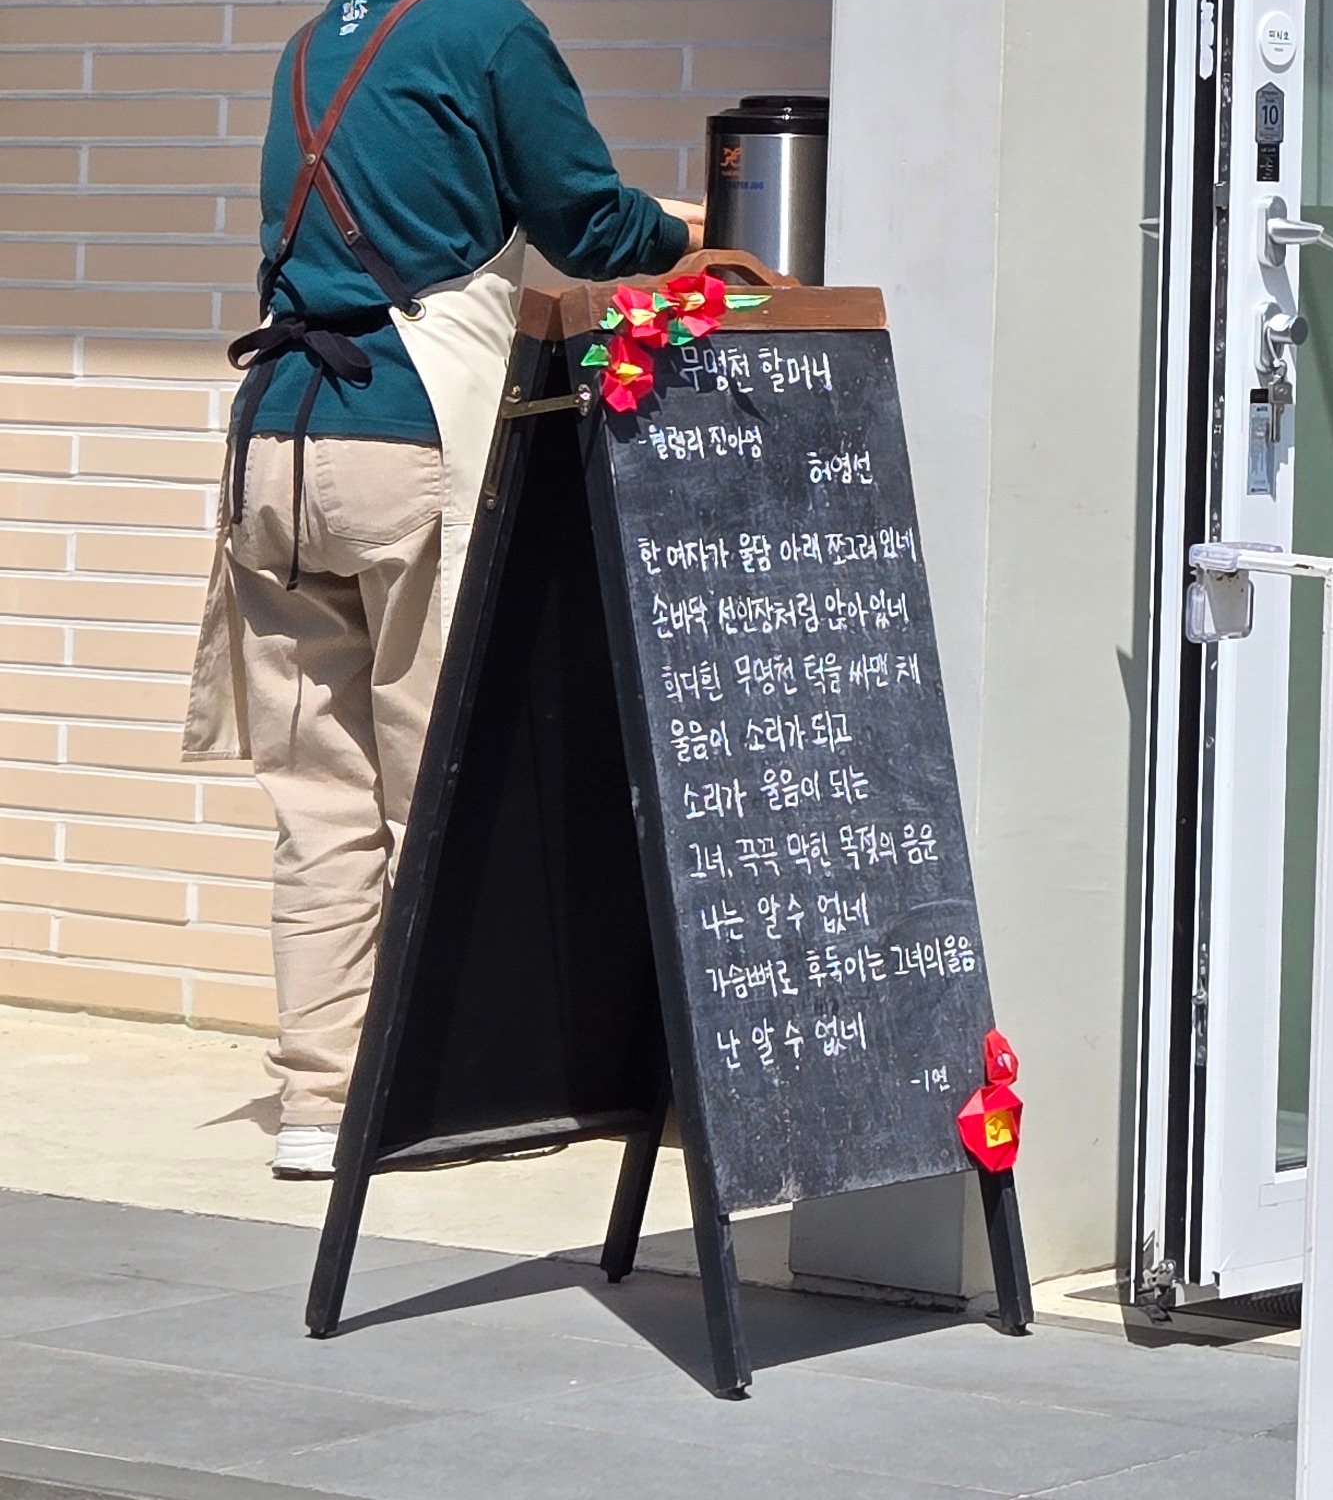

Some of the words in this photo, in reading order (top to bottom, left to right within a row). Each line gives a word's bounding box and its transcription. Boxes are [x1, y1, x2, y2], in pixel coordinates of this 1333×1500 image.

[680, 346, 753, 393] 무명천
[758, 348, 832, 393] 할머니
[806, 451, 873, 485] 허영선
[637, 537, 661, 575] 한
[666, 538, 729, 572] 여자가
[780, 532, 822, 564] 아래
[652, 592, 708, 639] 손바닥
[718, 592, 820, 633] 선인장처럼
[824, 588, 868, 631] 앉아
[869, 588, 909, 628] 있네
[661, 660, 724, 702] 희디흰
[735, 653, 797, 695] 무명천
[803, 652, 843, 695] 턱을
[895, 652, 922, 685] 채
[670, 718, 732, 762] 울음이
[744, 713, 804, 751] 소리가
[811, 709, 853, 752] 되고
[684, 778, 747, 819] 소리가
[760, 768, 821, 810] 울음이
[828, 764, 870, 805] 되는
[787, 831, 831, 875] 막힌
[701, 899, 745, 940] 나는
[757, 894, 782, 940] 알
[786, 893, 805, 931] 수
[817, 891, 870, 935] 없네
[706, 960, 799, 998] 가슴뼈로
[717, 1029, 741, 1070] 난
[752, 1017, 775, 1066] 알
[784, 1020, 804, 1058] 수
[814, 1011, 867, 1056] 없네
